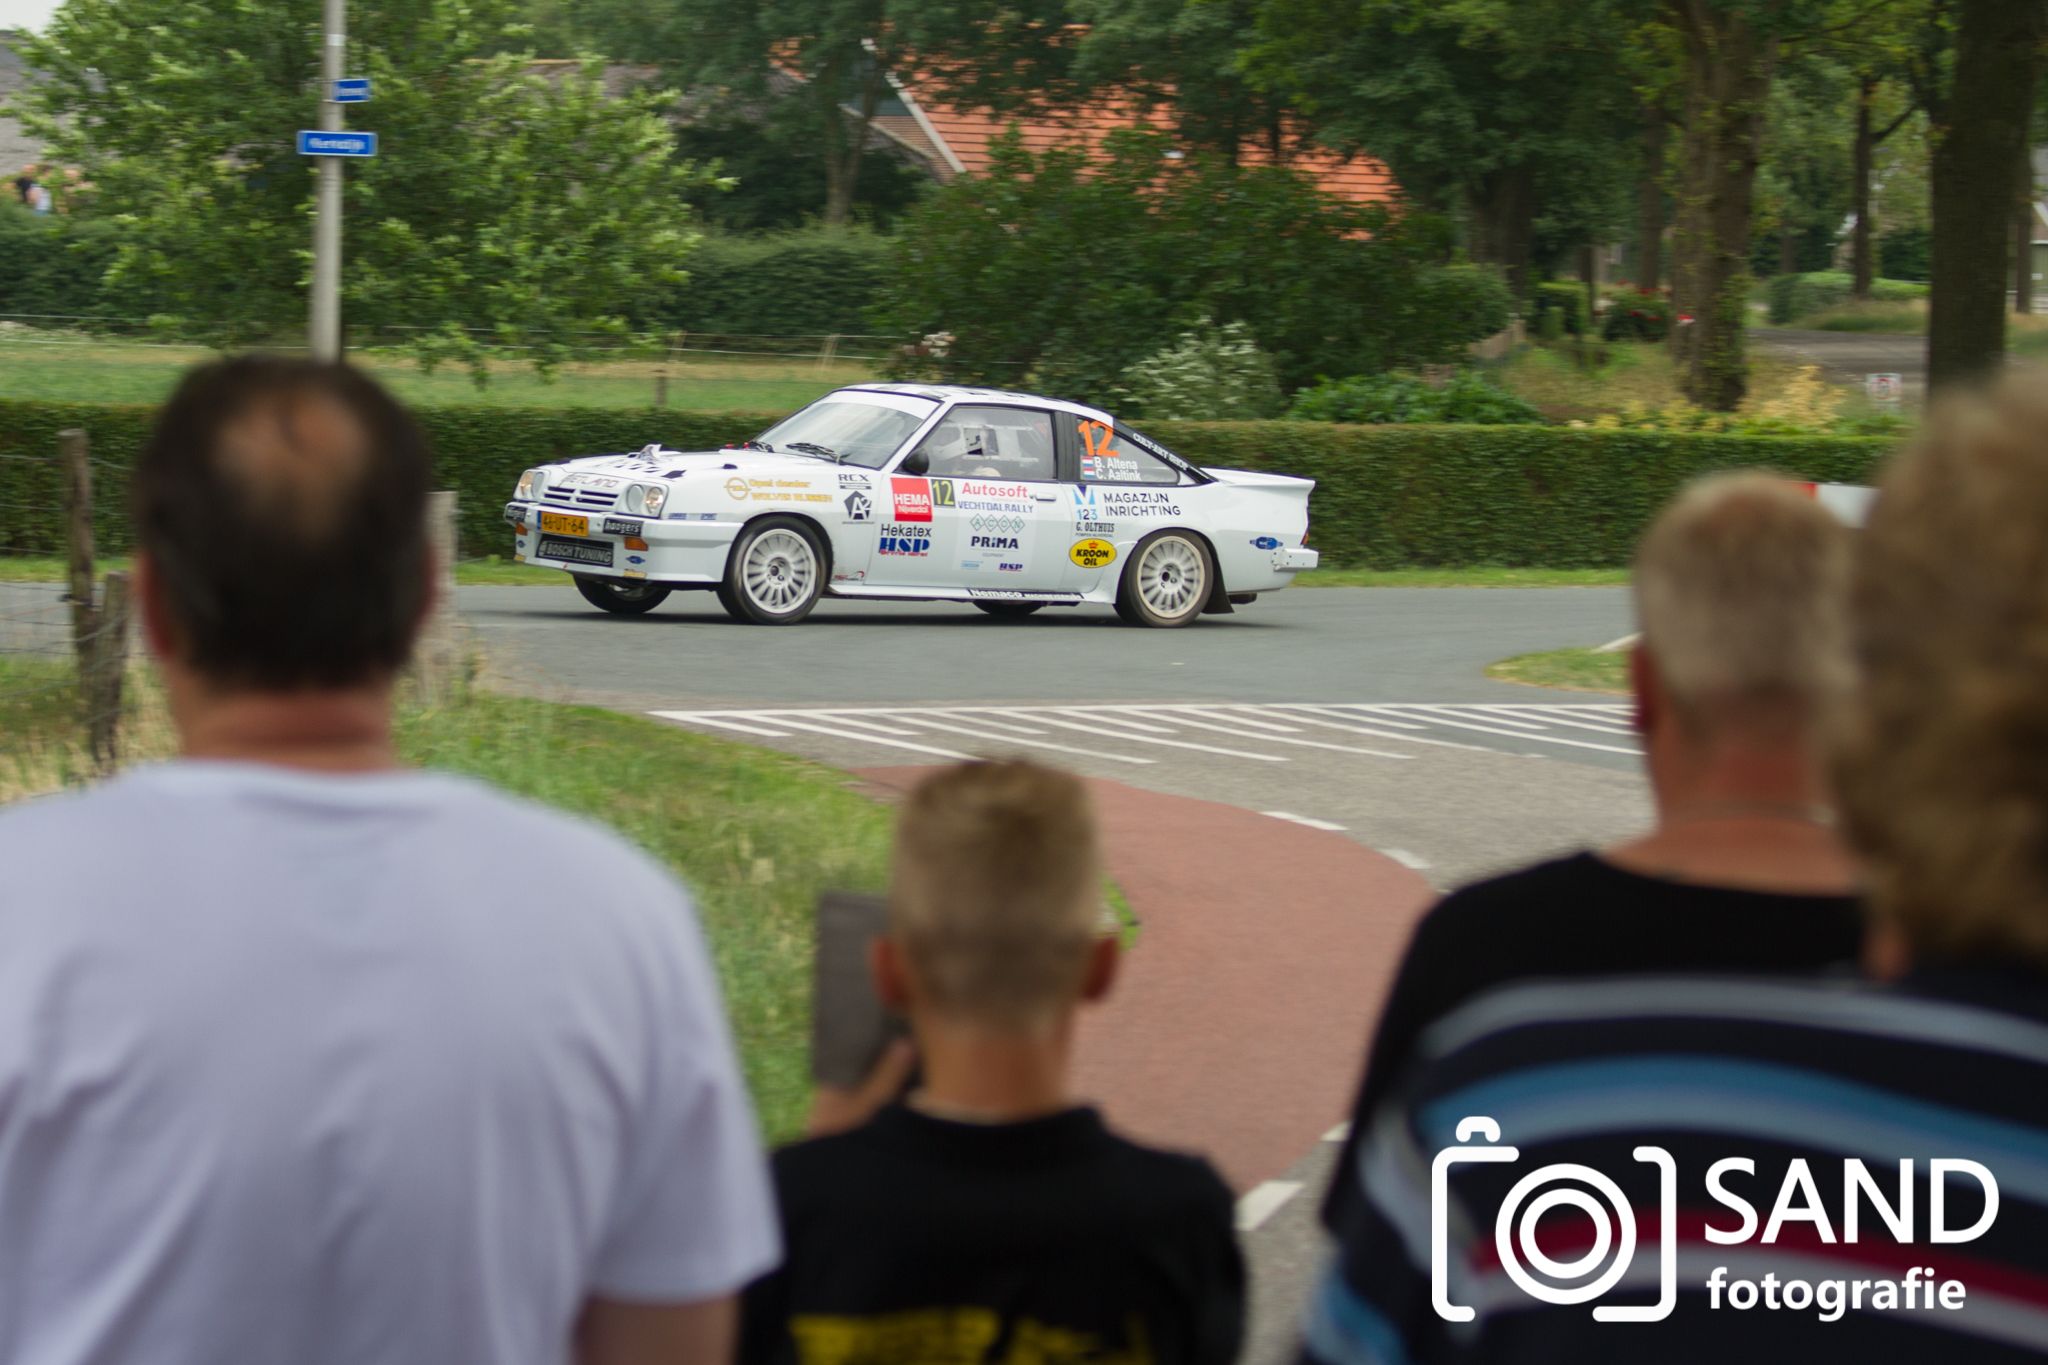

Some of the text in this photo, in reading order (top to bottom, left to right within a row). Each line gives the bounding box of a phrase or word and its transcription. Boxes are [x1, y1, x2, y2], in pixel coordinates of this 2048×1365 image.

[1078, 420, 1120, 457] 12
[1094, 457, 1138, 470] B. Altena
[1096, 469, 1142, 481] C. Aaltink
[933, 480, 955, 506] 12
[962, 482, 1028, 498] Autosoft
[894, 494, 930, 506] HEMA
[1103, 493, 1170, 504] MAGAZIJN
[958, 501, 1034, 514] VECHTDALRALLY
[1105, 505, 1181, 517] INRICHTING
[1076, 508, 1099, 520] 123
[880, 523, 932, 538] Hekatex
[1085, 522, 1116, 534] OLTHUIS
[879, 538, 931, 553] HSP
[1076, 549, 1110, 558] KROON
[1083, 558, 1098, 566] OIL
